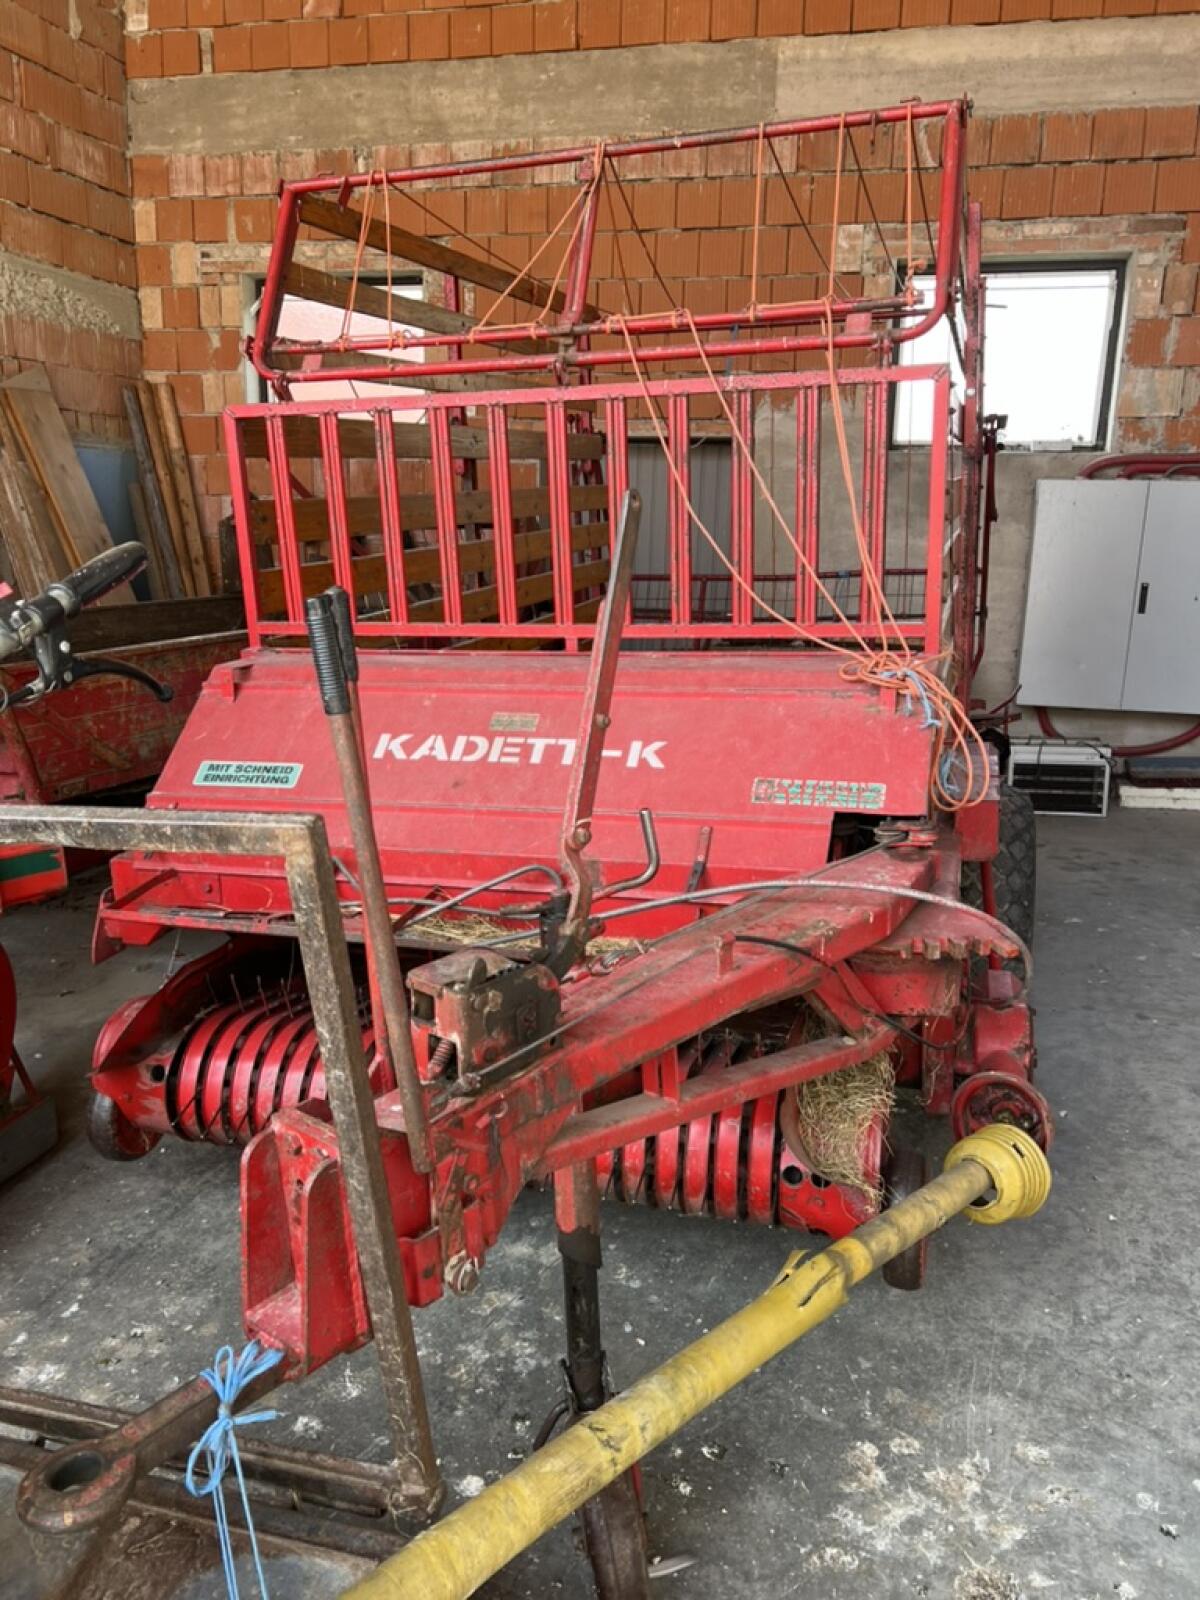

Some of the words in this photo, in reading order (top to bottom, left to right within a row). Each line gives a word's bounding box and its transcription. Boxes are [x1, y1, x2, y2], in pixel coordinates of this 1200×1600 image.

[207, 763, 233, 773] MIT
[234, 764, 294, 774] SCHNEID
[203, 773, 290, 784] EINRICHTUNG
